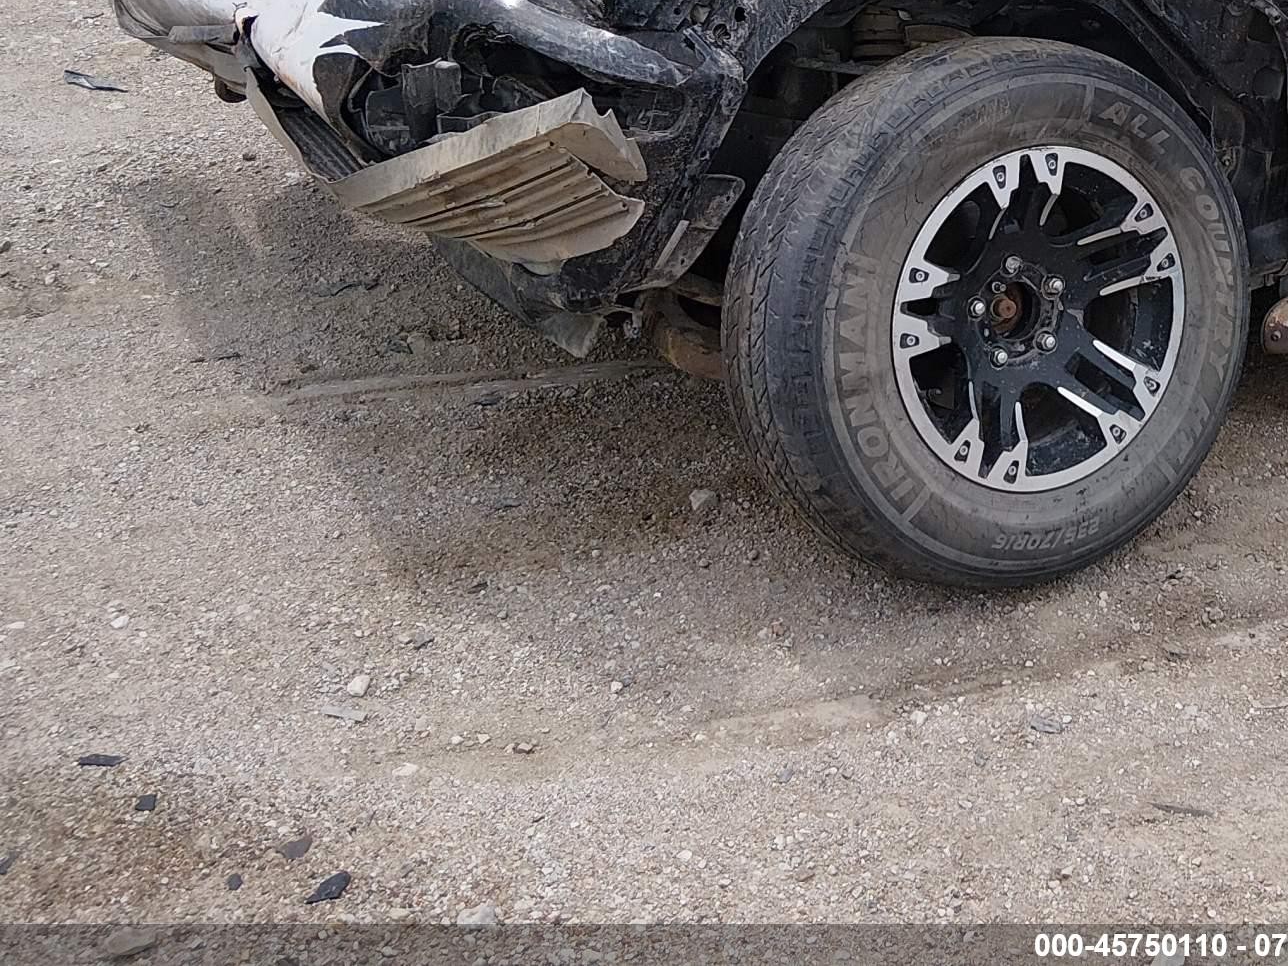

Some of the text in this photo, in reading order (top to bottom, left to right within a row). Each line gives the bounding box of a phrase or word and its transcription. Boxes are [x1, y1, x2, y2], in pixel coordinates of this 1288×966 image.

[1098, 101, 1171, 155] ALL
[1179, 166, 1235, 384] COUNTRY
[838, 272, 915, 502] IRONMAN
[991, 516, 1100, 551] 235/70R16
